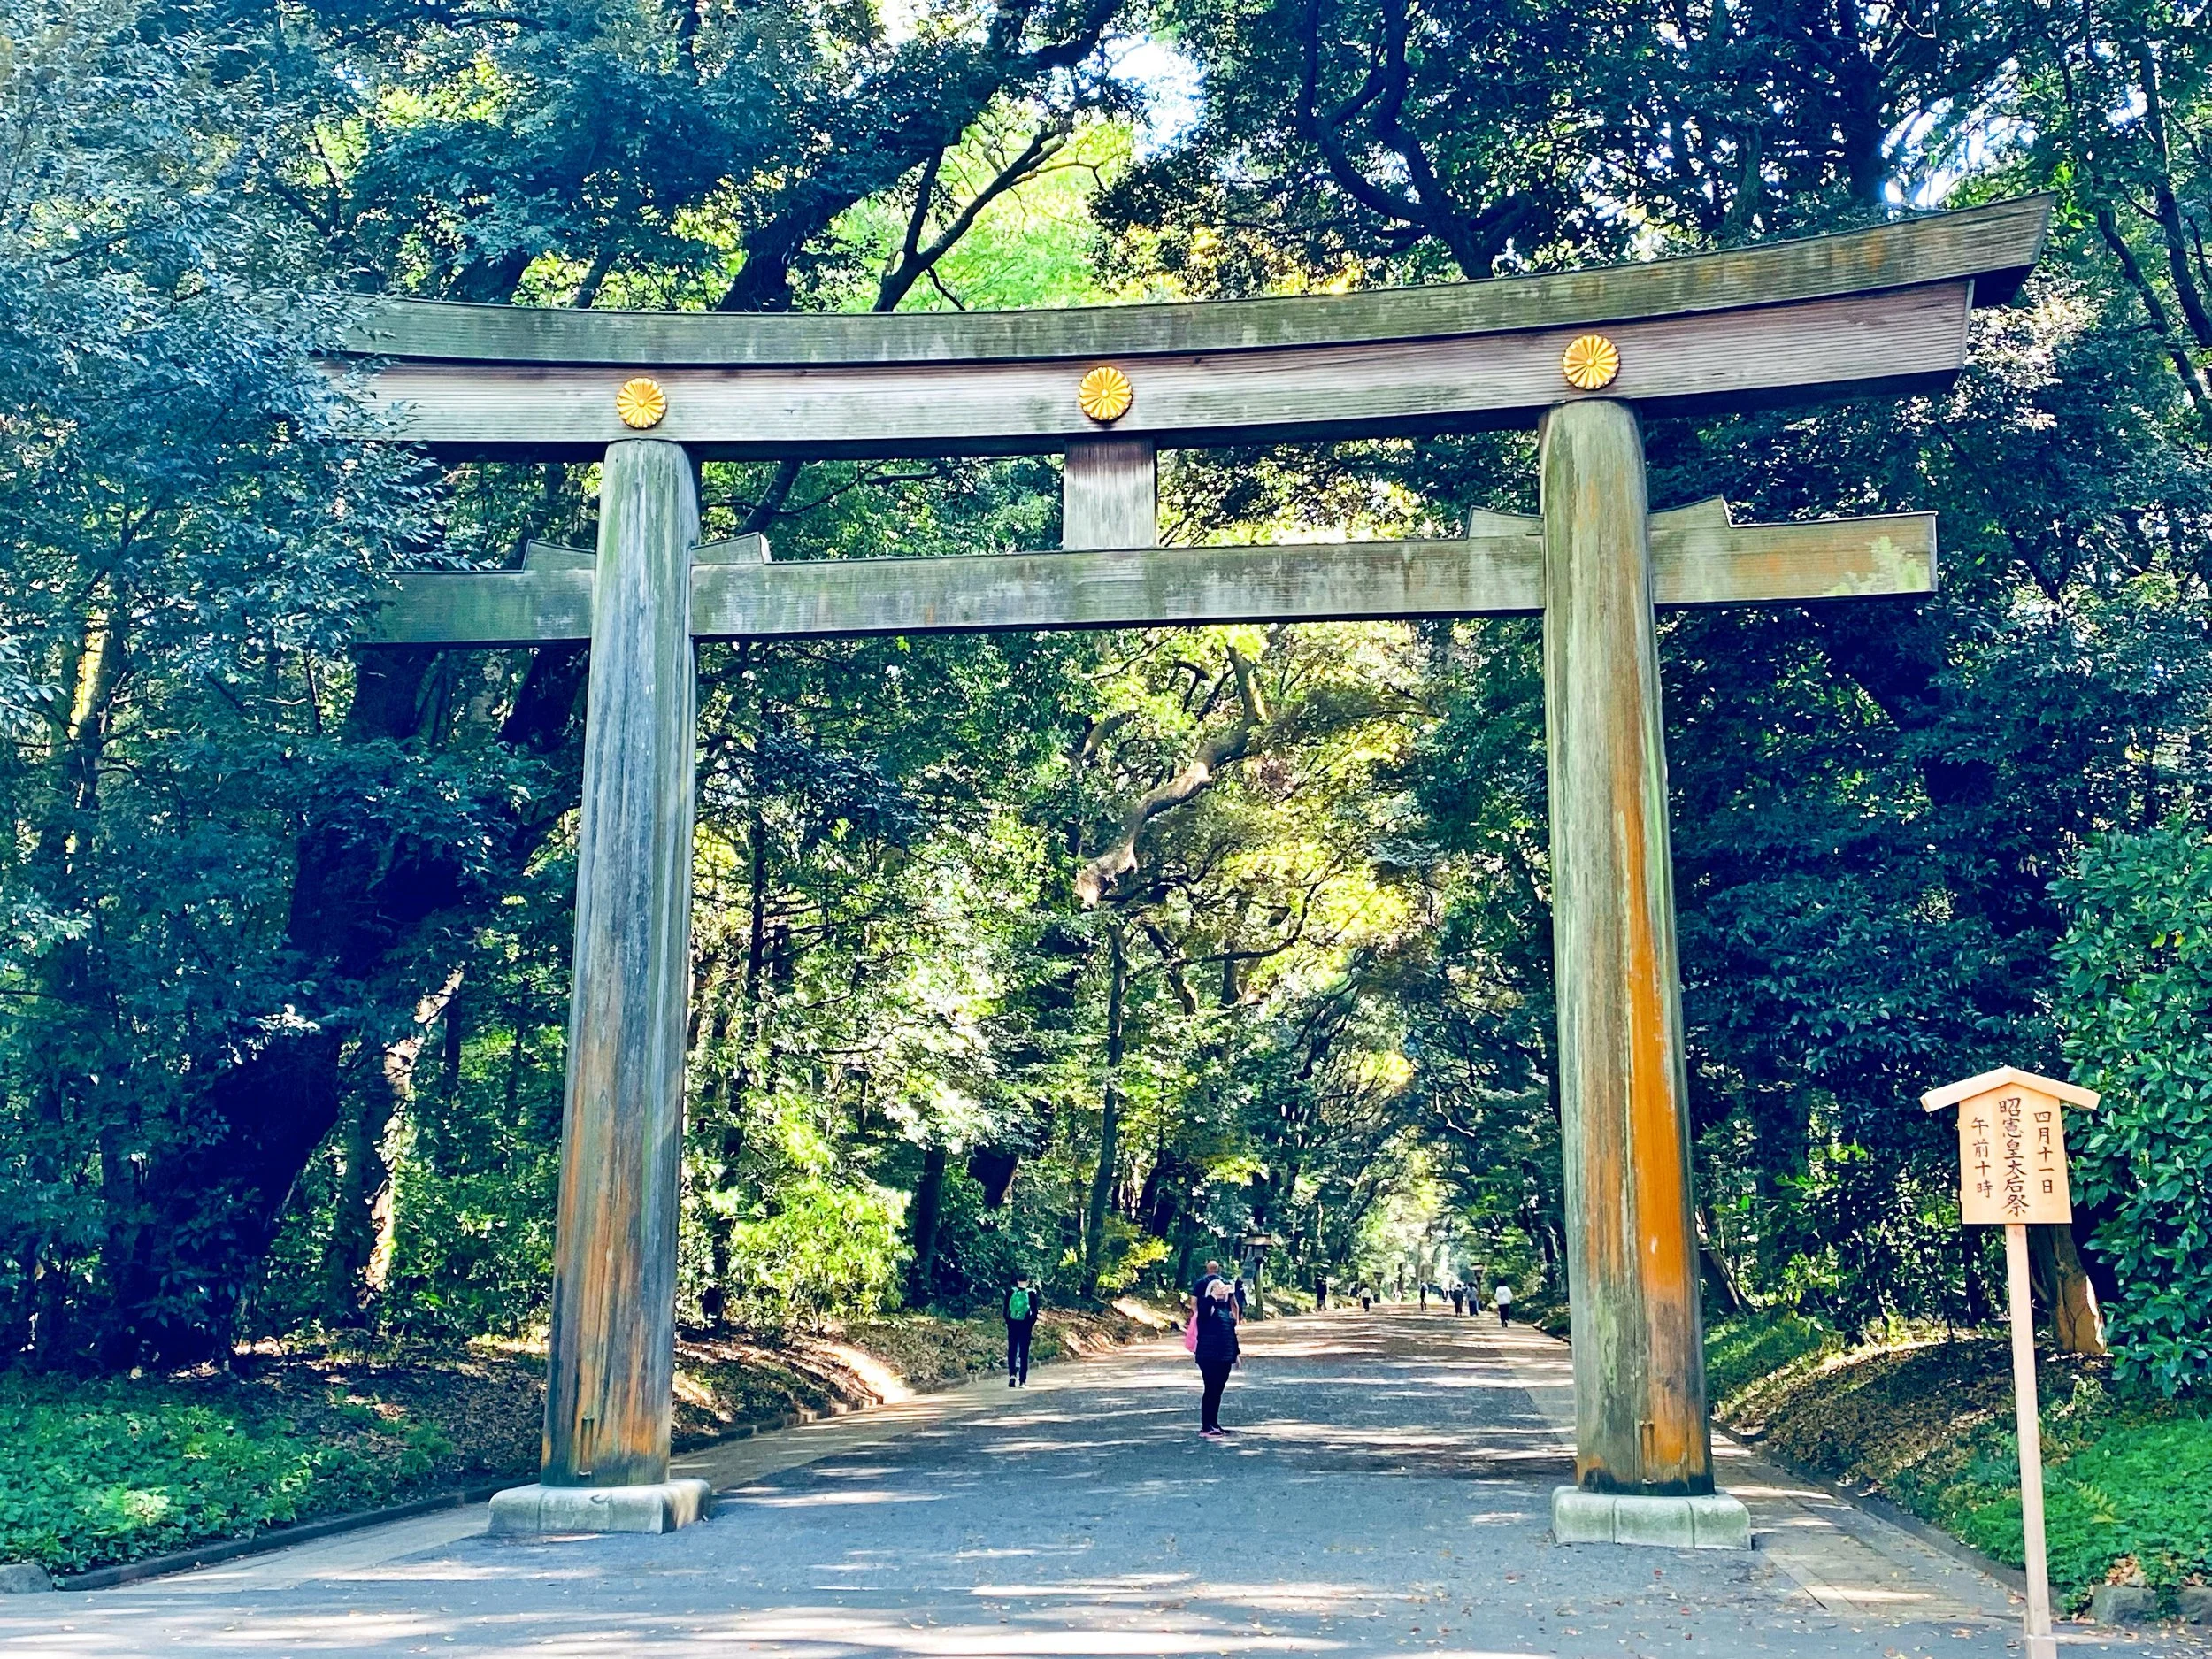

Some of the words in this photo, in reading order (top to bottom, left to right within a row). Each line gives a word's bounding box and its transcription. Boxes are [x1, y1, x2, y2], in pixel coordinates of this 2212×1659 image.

[1971, 1117, 1993, 1198] 午前十時
[2033, 1110, 2055, 1194] 四月十一日
